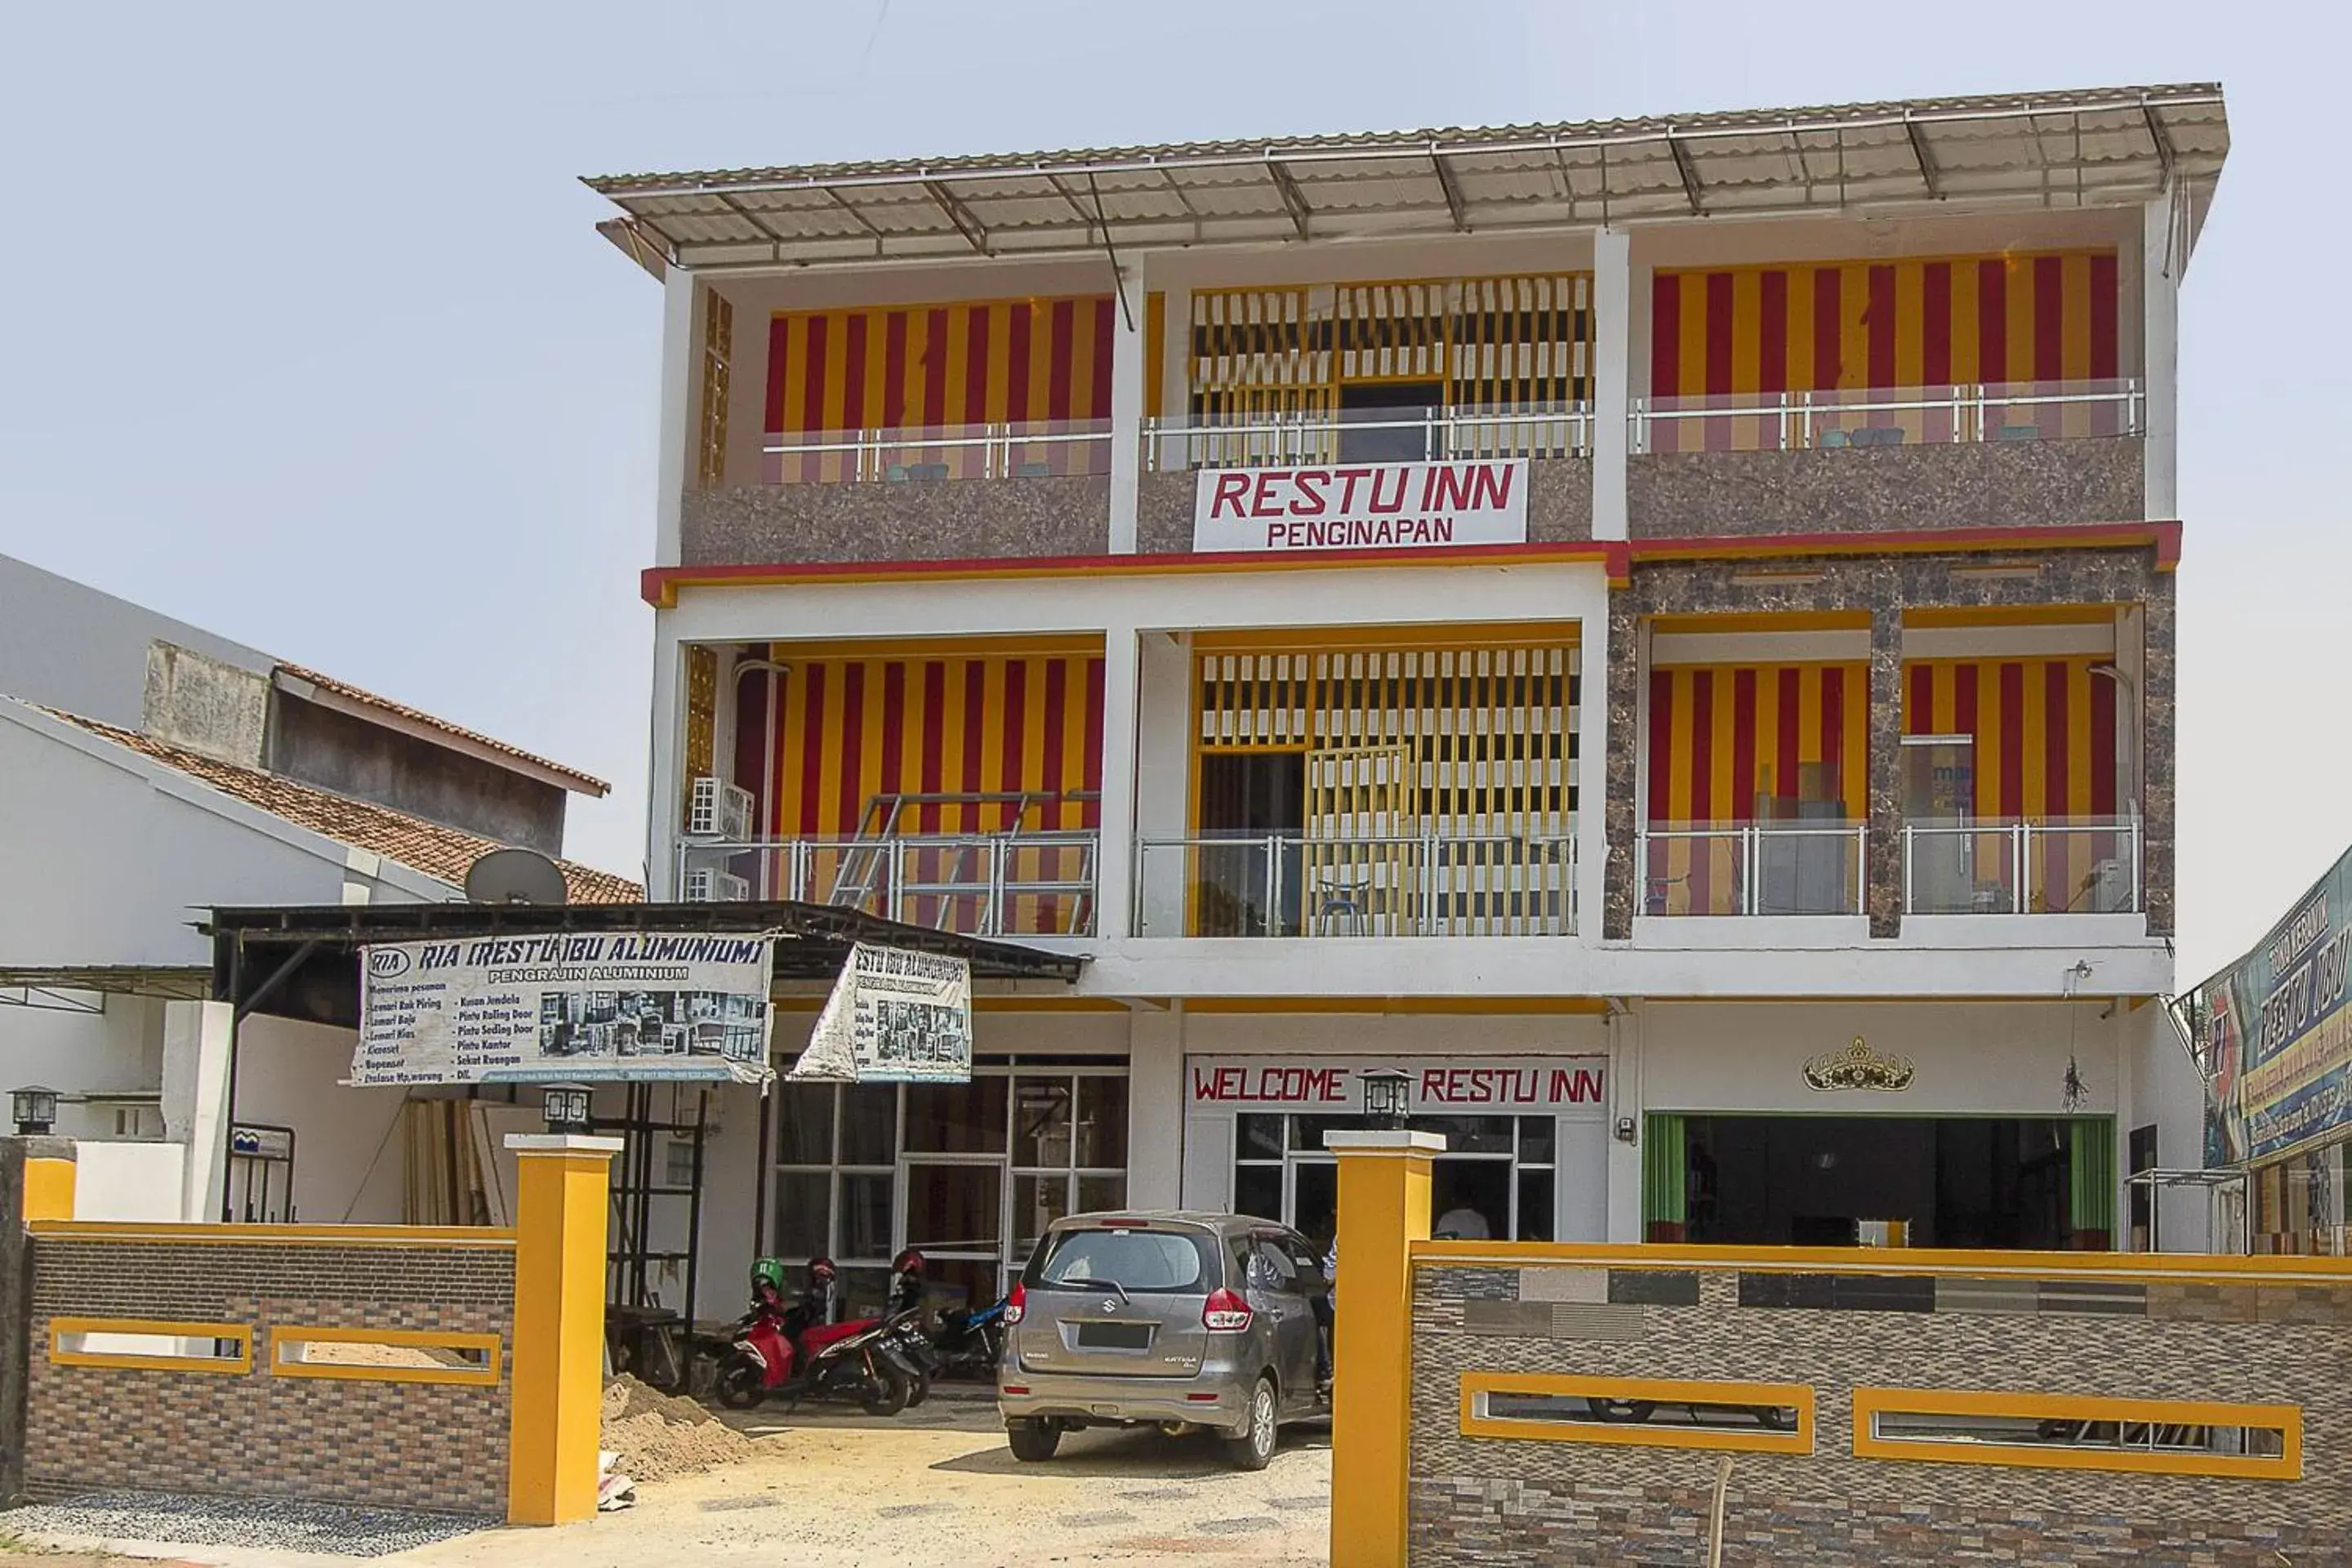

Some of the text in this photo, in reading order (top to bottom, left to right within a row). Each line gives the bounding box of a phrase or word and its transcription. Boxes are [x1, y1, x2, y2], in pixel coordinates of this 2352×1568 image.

[1211, 464, 1513, 519] RESTU INN
[1267, 518, 1453, 548] PENGINAPAN
[372, 954, 399, 971] RIA
[419, 944, 461, 969] RIA
[562, 938, 604, 962] IBU
[488, 967, 688, 983] PENGRAJIN ALUMINIUM
[1194, 1067, 1349, 1102] WELCOME
[1421, 1068, 1537, 1102] RESTU
[1549, 1069, 1604, 1103] INN
